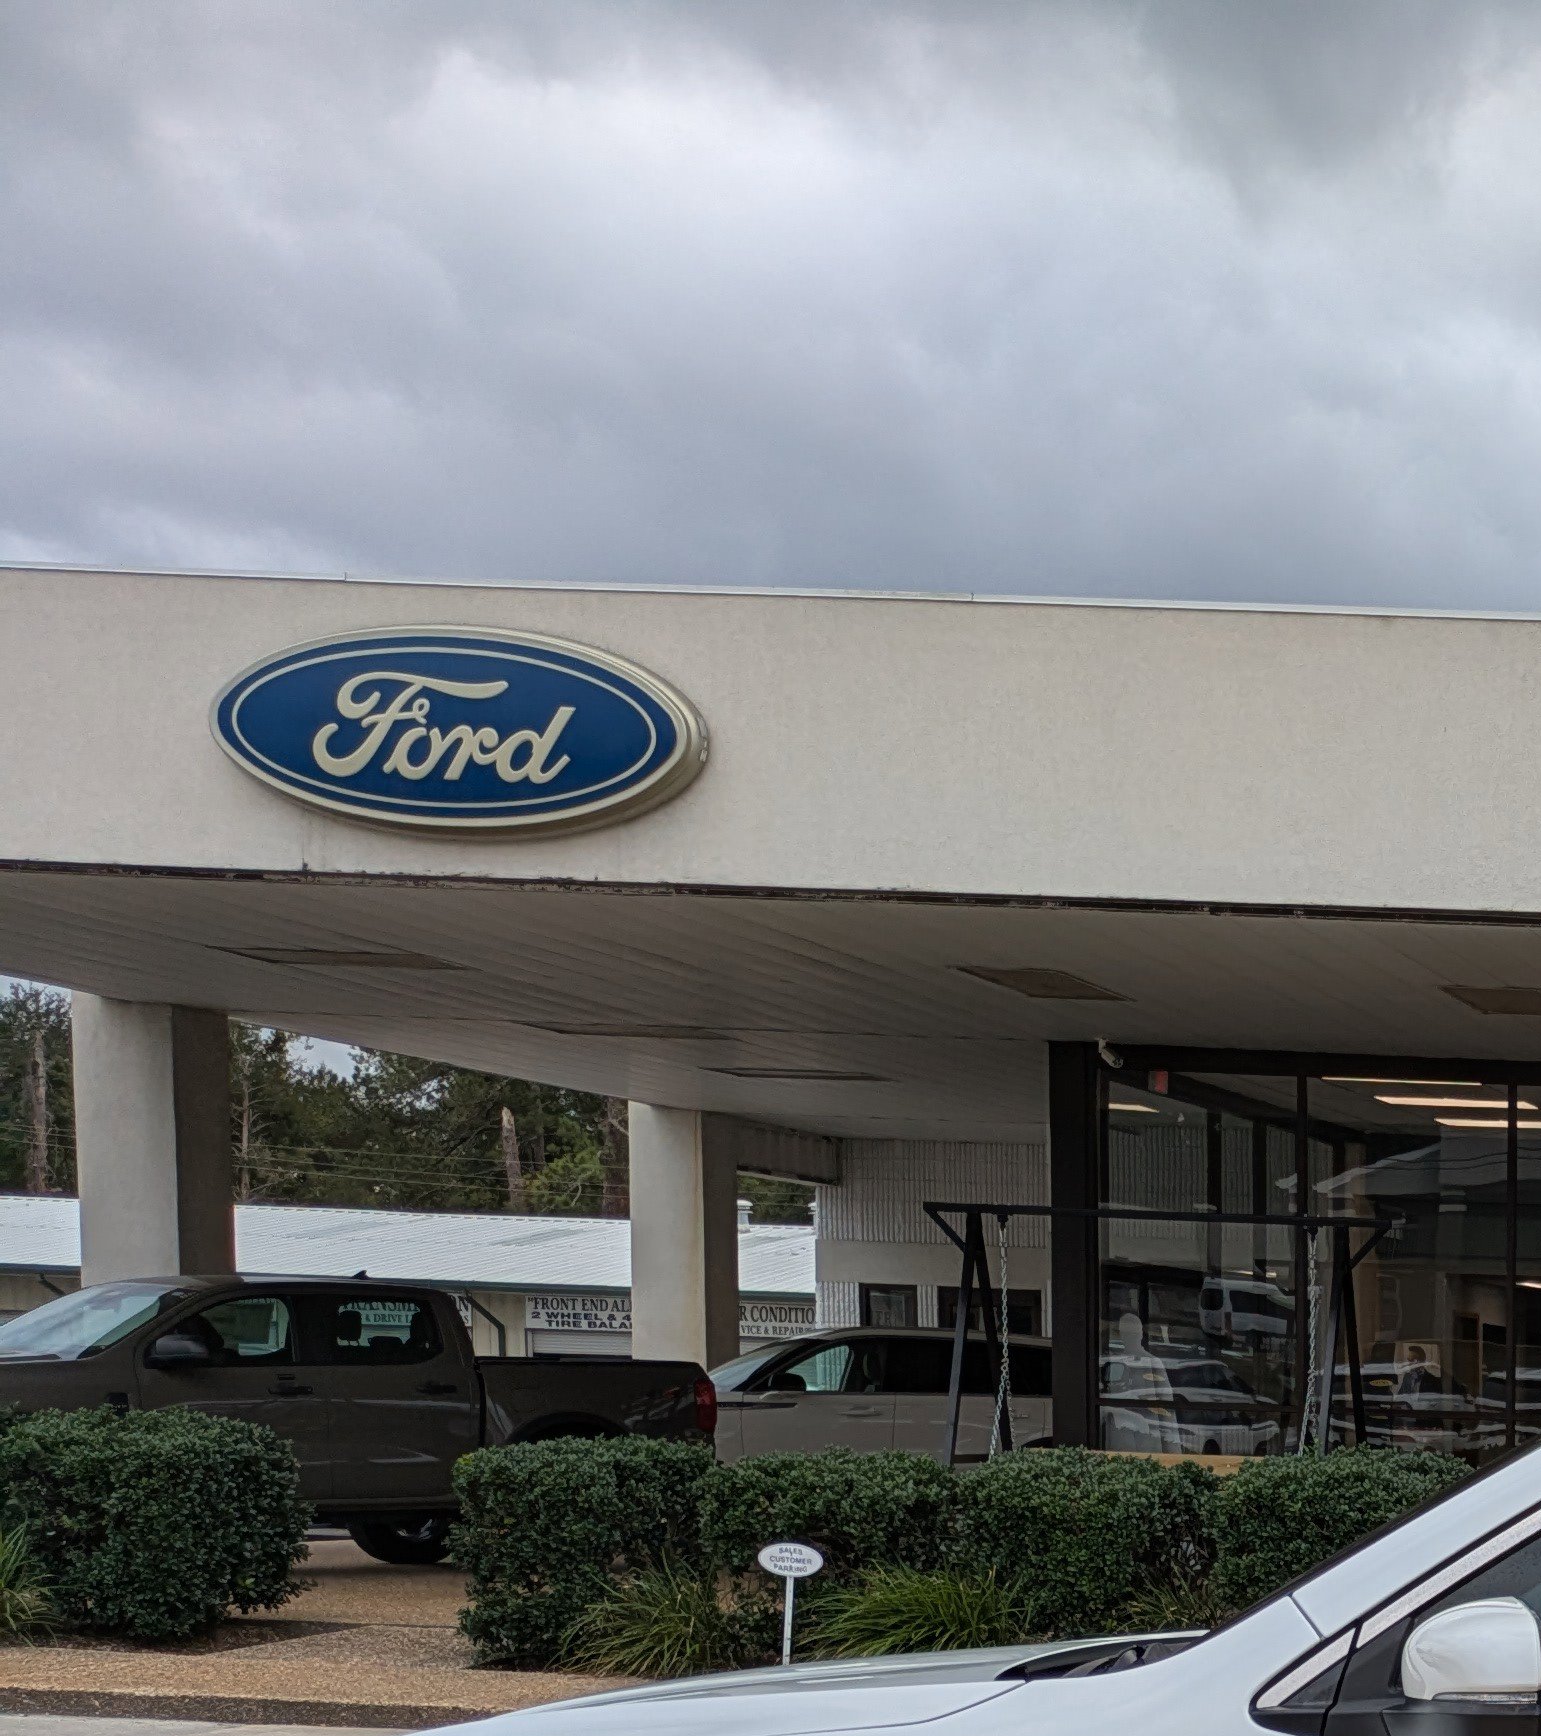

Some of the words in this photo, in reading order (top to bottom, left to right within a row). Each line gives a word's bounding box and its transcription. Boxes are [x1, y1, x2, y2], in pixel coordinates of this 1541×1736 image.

[312, 671, 576, 785] Ford
[582, 1298, 609, 1312] END
[531, 1311, 541, 1319] 2
[545, 1312, 603, 1320] WHEEL
[750, 1305, 815, 1324] CONDITIO
[545, 1320, 582, 1328] TIRE
[769, 1555, 813, 1566] CUSTOMER
[773, 1563, 808, 1573] PARKING
